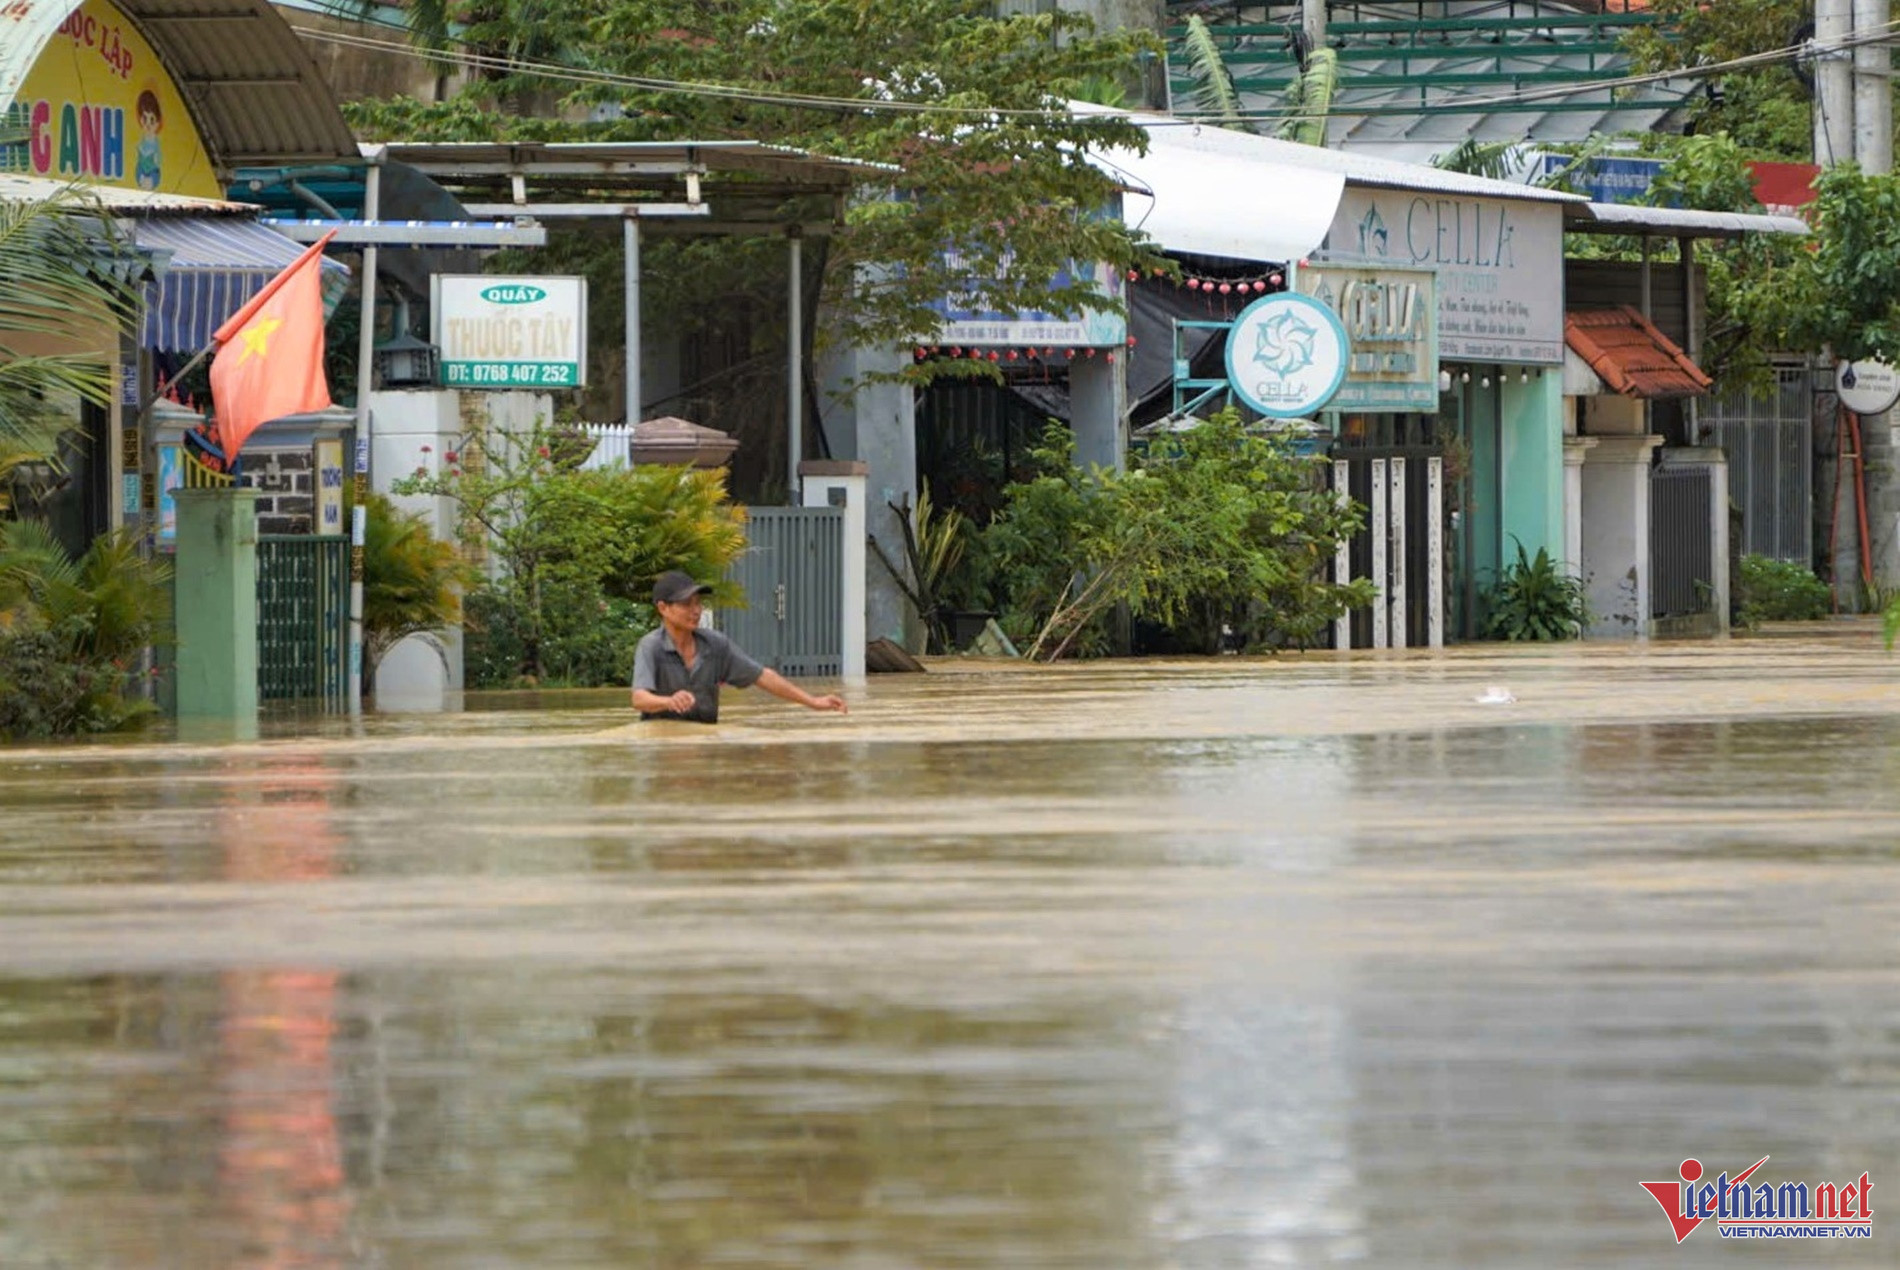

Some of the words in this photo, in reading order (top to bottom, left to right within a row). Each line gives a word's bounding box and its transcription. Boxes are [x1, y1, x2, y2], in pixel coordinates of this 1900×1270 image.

[100, 26, 133, 79] LẬP
[59, 103, 124, 178] ANH
[1407, 195, 1514, 269] CELLA
[447, 307, 523, 358] THUỐC
[528, 311, 572, 357] TÂY
[473, 364, 509, 382] 0768
[512, 364, 538, 382] 407
[542, 364, 569, 383] 252
[1256, 380, 1309, 398] CELLA
